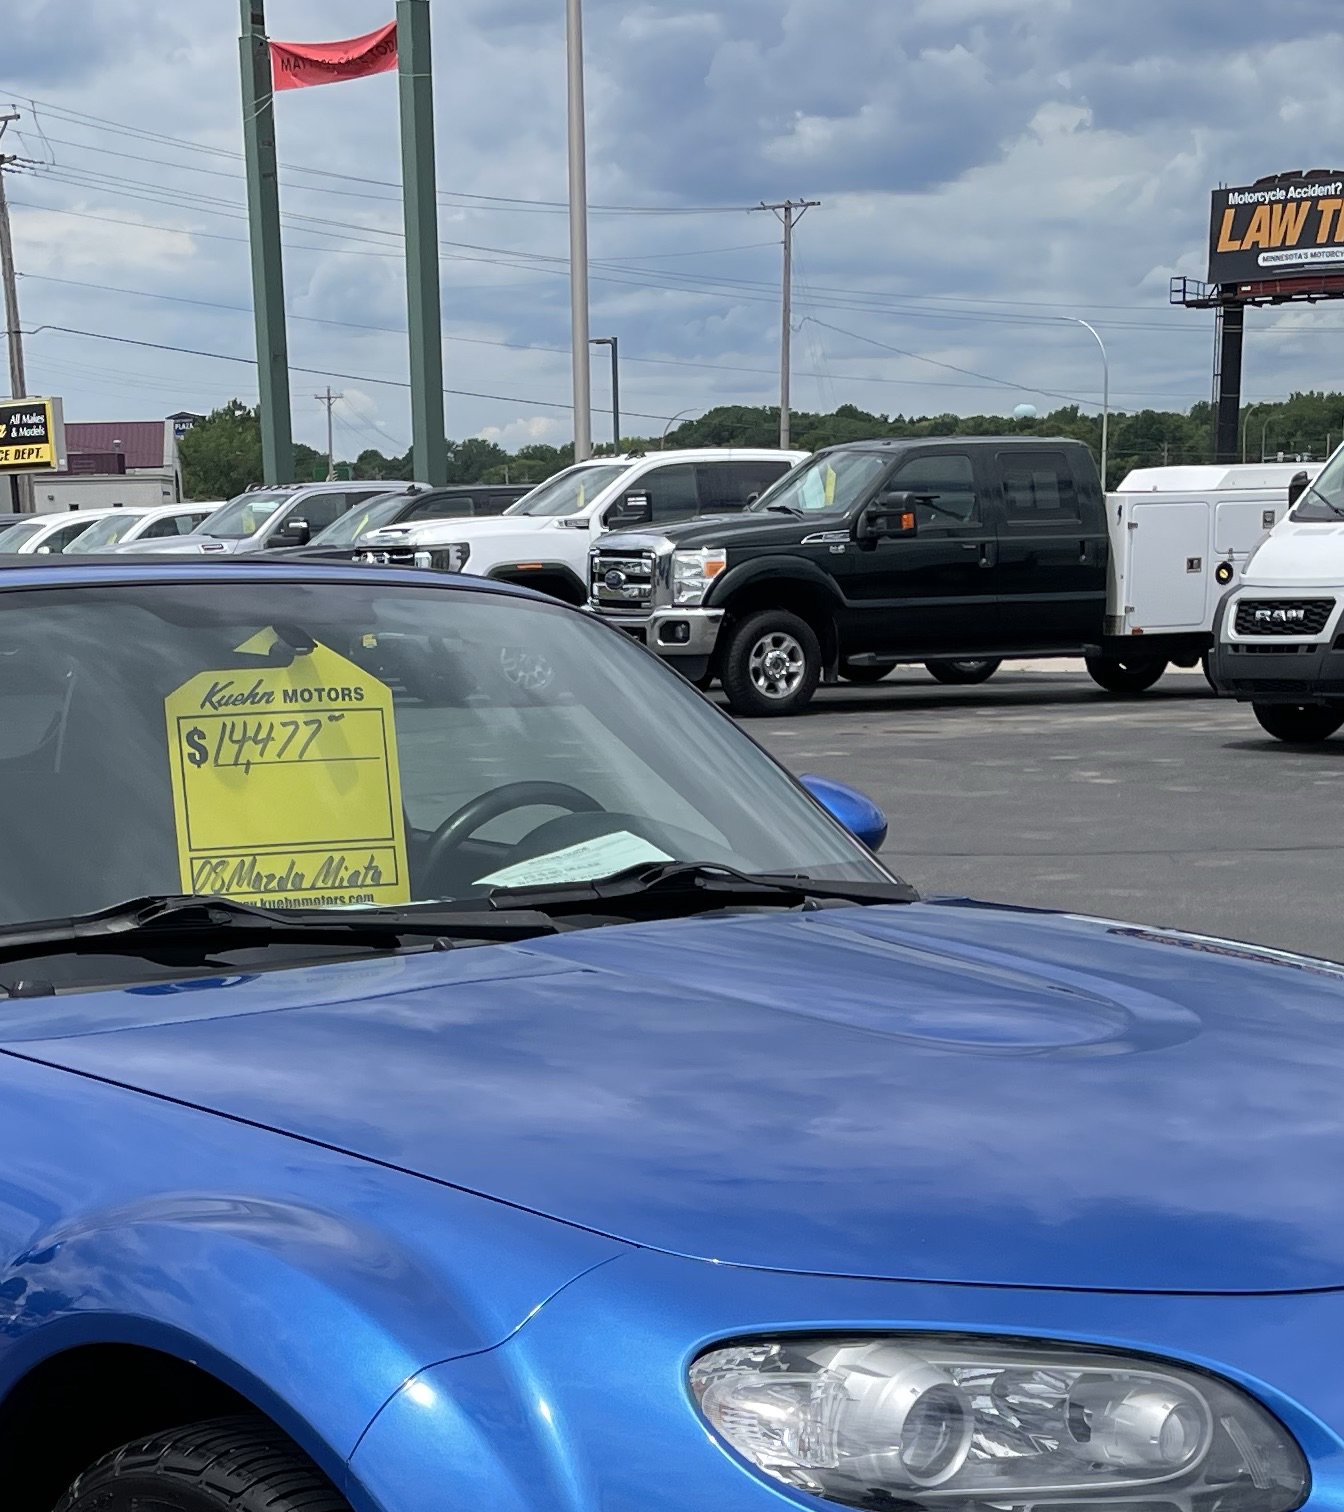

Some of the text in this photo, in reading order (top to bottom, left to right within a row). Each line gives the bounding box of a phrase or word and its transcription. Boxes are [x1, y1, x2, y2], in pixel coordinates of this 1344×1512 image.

[1228, 182, 1343, 206] Motorcycle Accident?
[1217, 201, 1311, 252] LAW
[1262, 250, 1308, 263] MINNESOTA'S
[9, 411, 45, 424] All Makes
[10, 424, 45, 438] & Models
[174, 422, 194, 431] PLAZA
[13, 447, 44, 461] DEPT.
[1255, 609, 1305, 622] RAM
[200, 679, 365, 711] Kuehn MOTORS
[227, 856, 306, 892] Mazda
[309, 854, 383, 889] Miata
